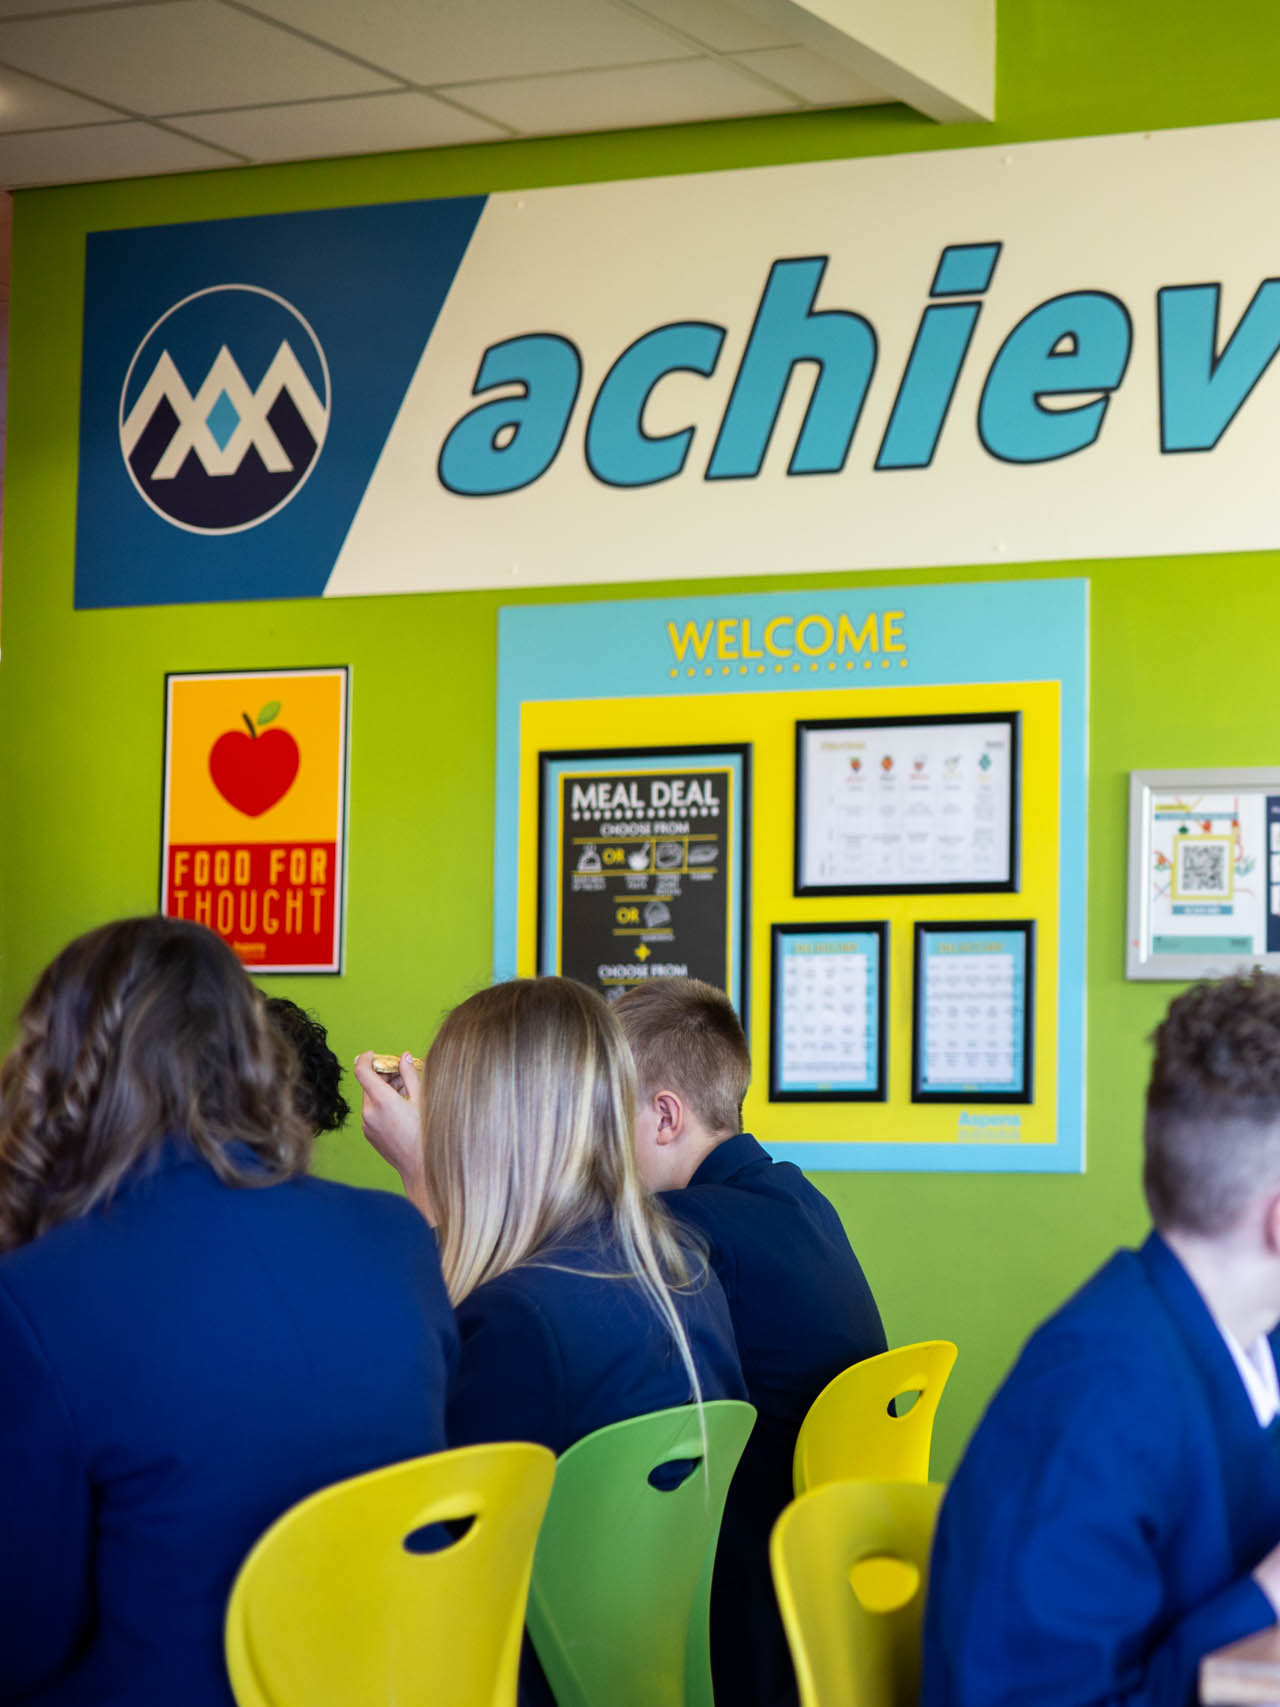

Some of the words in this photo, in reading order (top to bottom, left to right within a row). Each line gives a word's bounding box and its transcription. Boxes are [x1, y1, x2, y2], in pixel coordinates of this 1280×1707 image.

[667, 610, 907, 662] WELCOME
[572, 782, 645, 810] MEAL
[650, 780, 720, 807] DEAL
[600, 823, 651, 836] CHOOSE
[653, 822, 689, 834] FROM
[173, 850, 251, 887] FOOD
[270, 848, 328, 886] FOR
[602, 848, 625, 865] OR
[173, 887, 326, 935] THOUGHT
[616, 907, 640, 924] OR
[598, 964, 648, 979] CHOOSE
[650, 963, 688, 977] FROM
